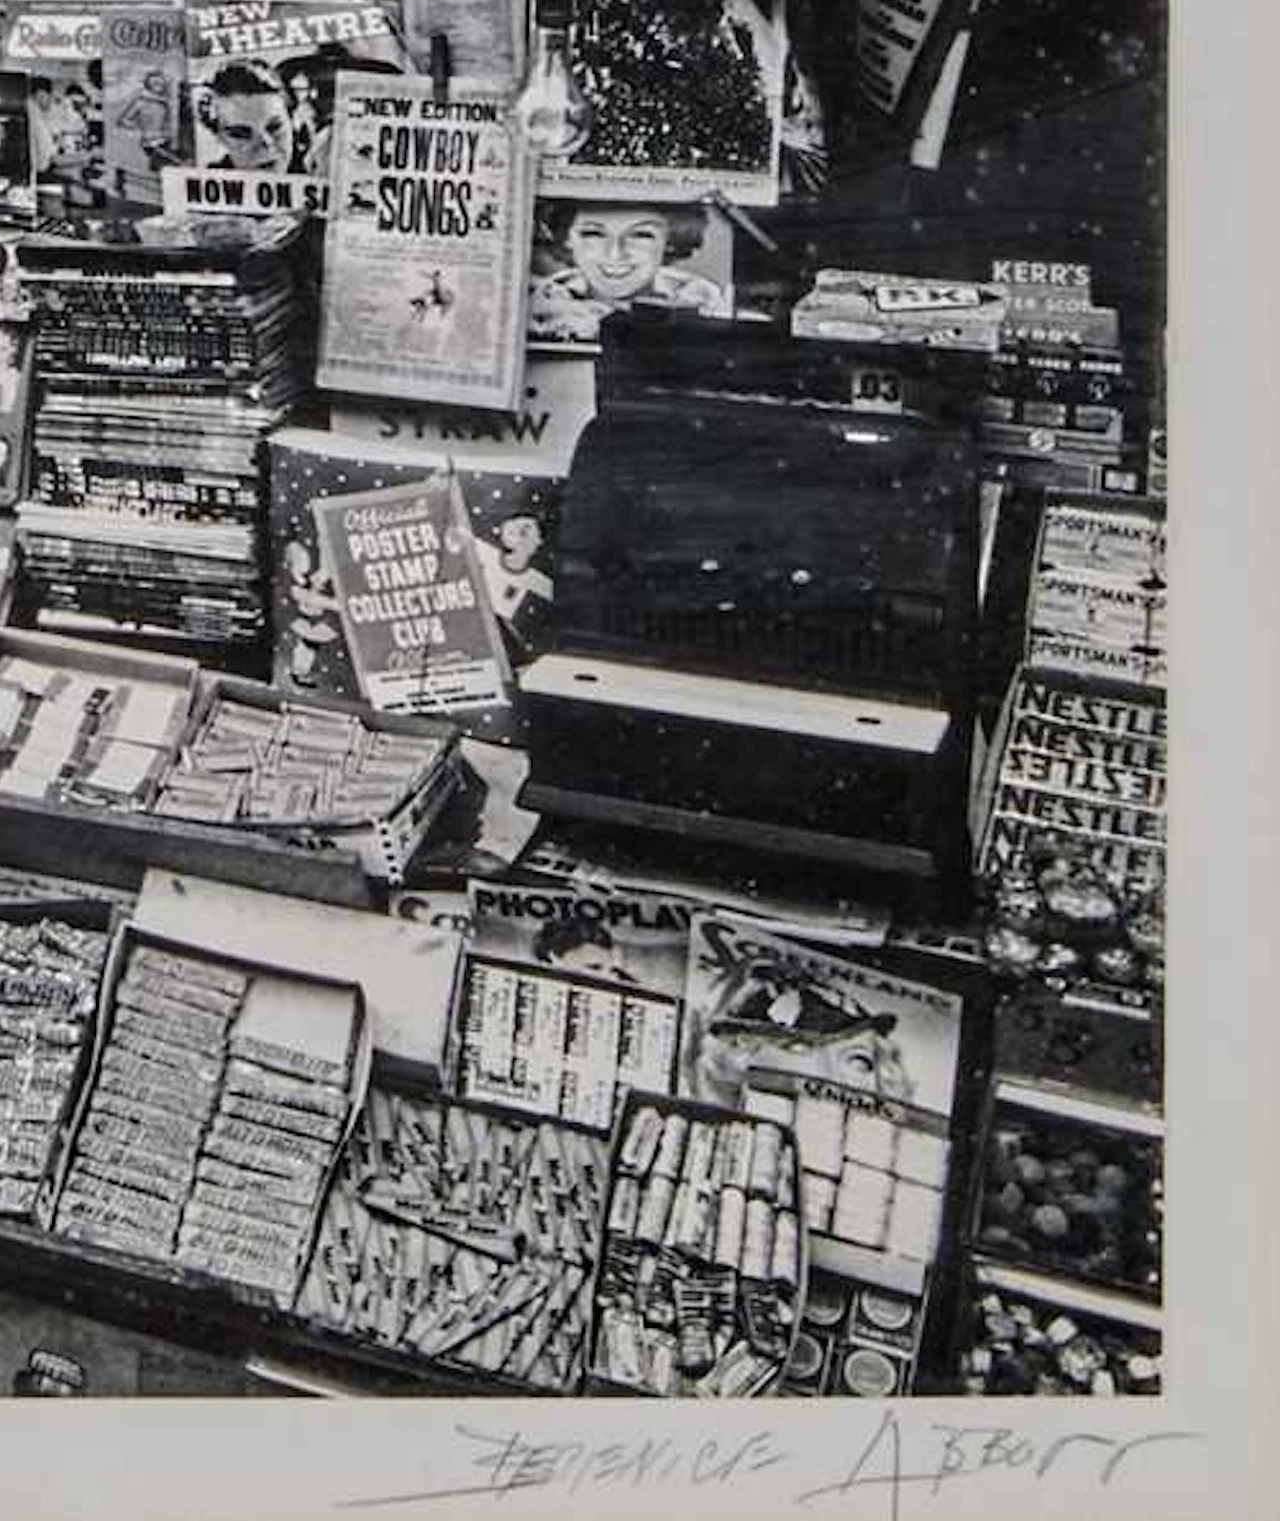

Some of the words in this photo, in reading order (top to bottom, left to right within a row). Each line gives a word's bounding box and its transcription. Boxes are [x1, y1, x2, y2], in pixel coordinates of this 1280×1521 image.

[197, 0, 270, 29] NEW
[202, 8, 390, 56] THEATRE
[366, 99, 413, 118] NEW
[421, 100, 497, 122] EDITION
[378, 124, 480, 176] COWBOY
[186, 175, 241, 206] NOW
[257, 181, 293, 208] ON
[376, 177, 472, 238] SONGS
[992, 259, 1092, 287] KERR'S
[348, 522, 440, 563] POSTER
[364, 554, 439, 591] STAMP
[347, 578, 475, 625] COLLECTORS
[476, 889, 705, 931] PHOTOPLAY
